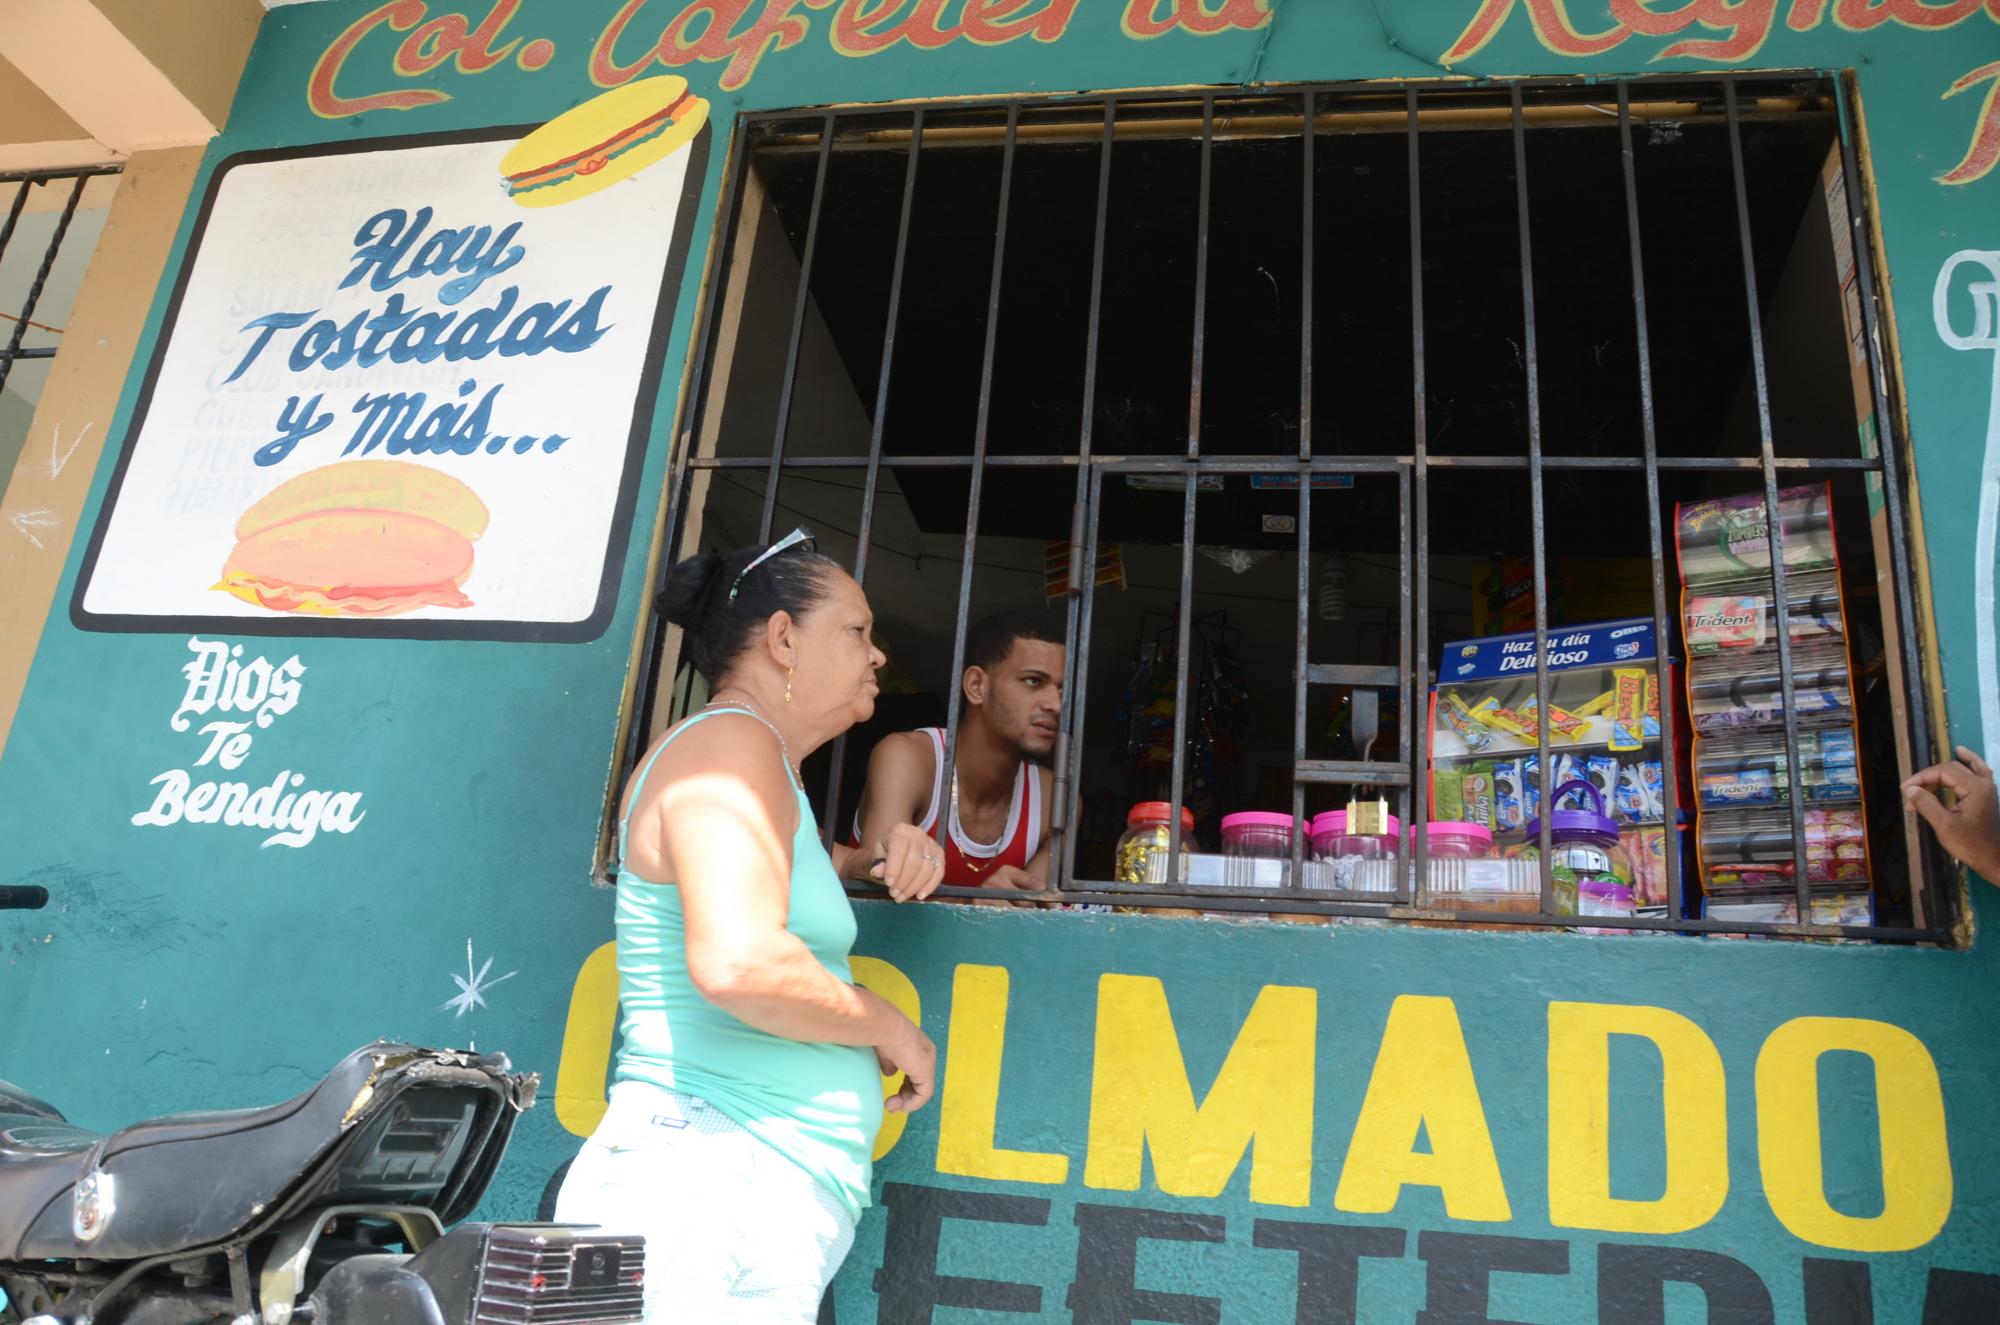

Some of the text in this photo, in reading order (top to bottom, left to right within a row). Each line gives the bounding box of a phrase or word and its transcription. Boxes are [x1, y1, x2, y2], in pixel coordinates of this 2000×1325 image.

[340, 206, 525, 305] Hay
[223, 284, 615, 386] Tostadas
[1610, 625, 1648, 639] OREO
[1694, 613, 1751, 628] Trident
[1501, 640, 1535, 654] Haz
[1561, 631, 1591, 648] día
[1499, 650, 1589, 672] Deliioso
[171, 636, 308, 732] Dios
[192, 720, 253, 770] Te
[1710, 783, 1762, 797] Trident
[130, 768, 367, 849] Bendiga
